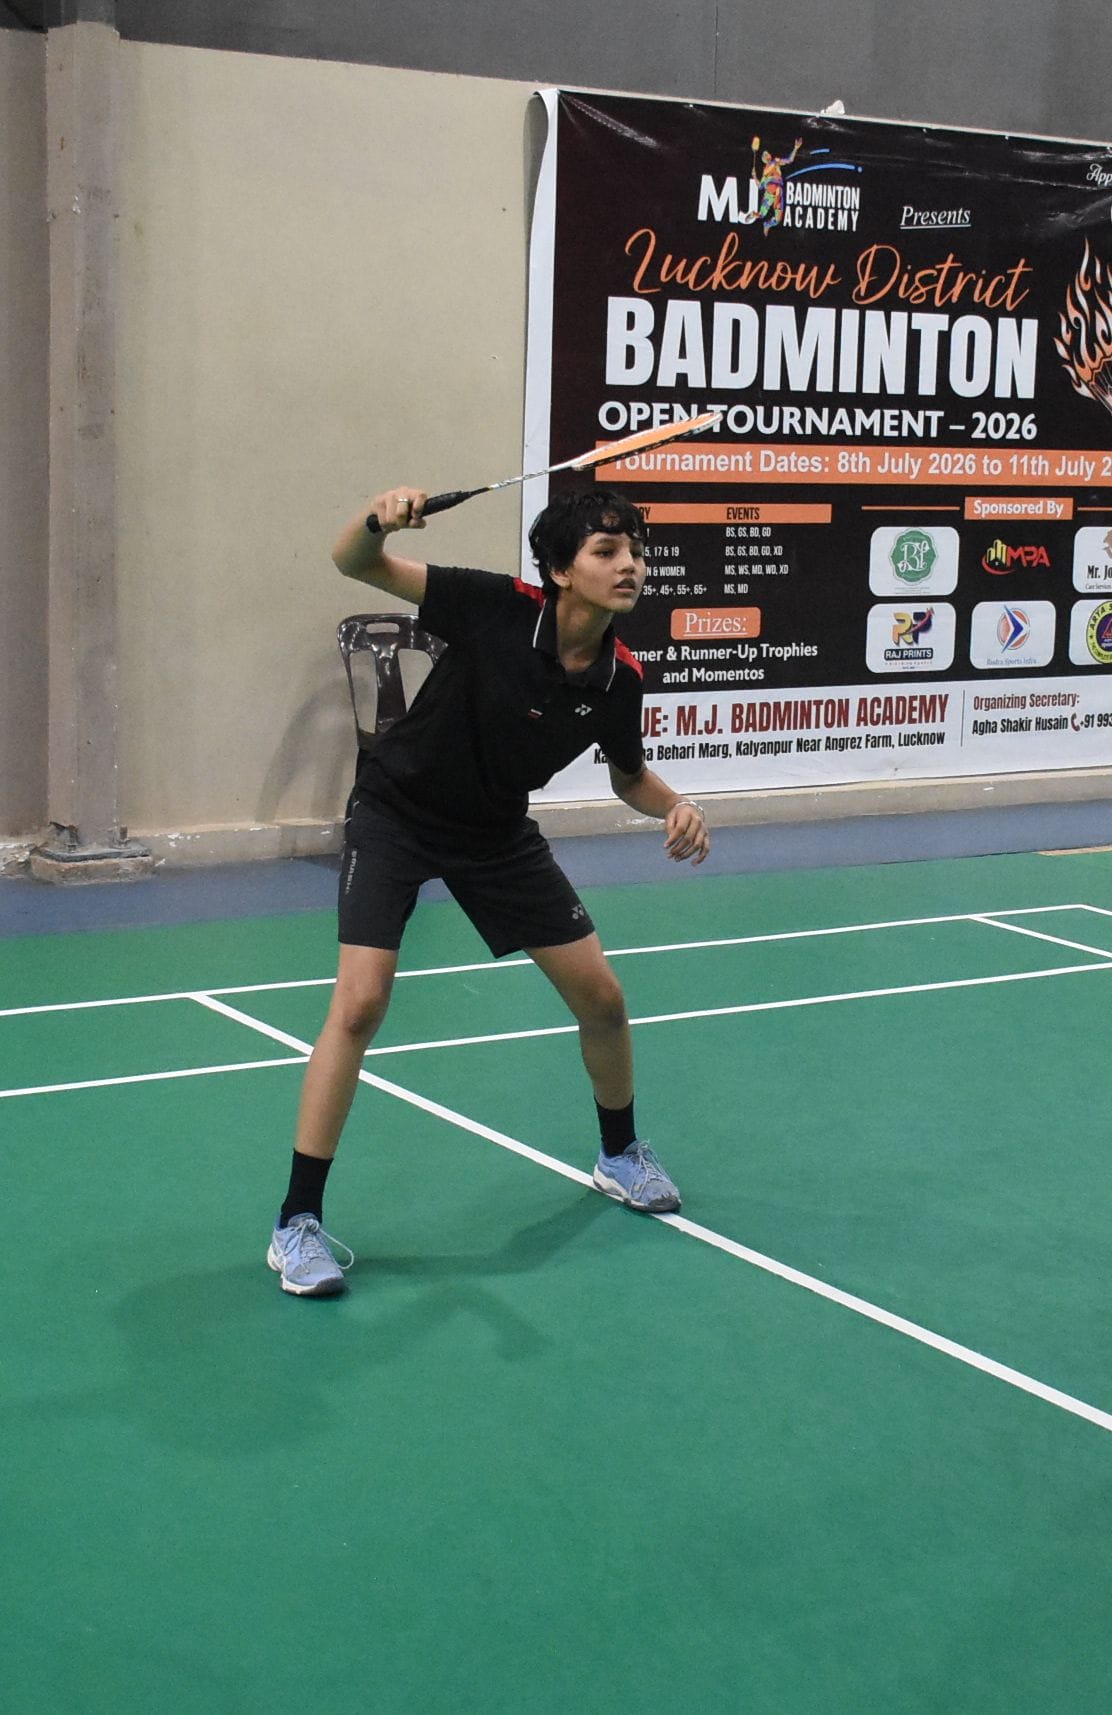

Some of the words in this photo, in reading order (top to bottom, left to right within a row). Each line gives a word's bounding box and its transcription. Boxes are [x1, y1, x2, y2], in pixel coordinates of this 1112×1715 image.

[697, 174, 760, 225] MJ
[786, 181, 861, 210] BADMINTON
[783, 206, 859, 232] ACADEMY
[900, 205, 971, 226] Presents
[624, 228, 840, 299] Lucknow
[852, 243, 1033, 311] District
[605, 296, 1039, 399] BADMINTON
[706, 403, 945, 438] TOURNAMENT
[971, 411, 1038, 440] 2026
[759, 450, 830, 473] Dates:
[837, 452, 871, 474] 8th
[877, 453, 922, 479] July
[928, 454, 976, 475] 2026
[982, 457, 1003, 475] to
[1009, 454, 1049, 476] 11th
[1055, 456, 1096, 481] July
[726, 507, 760, 520] EVENTS
[973, 499, 1043, 517] Sponsored
[1046, 500, 1064, 518] By
[726, 527, 736, 538] BS,
[654, 546, 662, 557] 17
[671, 546, 679, 556] 19
[725, 546, 736, 557] BS,
[773, 546, 783, 556] XD
[659, 566, 686, 577] WOMEN
[724, 565, 737, 576] MS,
[779, 564, 789, 575] XD
[1087, 564, 1101, 579] Mr.
[643, 585, 659, 596] 35+,
[660, 585, 676, 596] 45+,
[677, 585, 693, 596] 55+,
[724, 584, 736, 595] MS,
[737, 584, 748, 594] MD
[684, 612, 748, 633] Prizes:
[630, 650, 663, 662] nner
[666, 646, 678, 661] &
[681, 645, 757, 662] Runner-Up
[760, 642, 818, 661] Trophies
[886, 650, 901, 658] RAJ
[903, 649, 932, 658] PRINTS
[663, 668, 688, 683] and
[692, 667, 765, 683] Momentos
[973, 694, 1026, 711] Organizing
[1029, 692, 1080, 708] Secretary:
[676, 704, 723, 736] M.J.
[731, 698, 850, 733] BADMINTON
[856, 694, 949, 727] ACADEMY
[972, 719, 997, 735] Agha
[1000, 716, 1032, 732] Shakir
[1035, 714, 1068, 731] Husain
[657, 742, 695, 761] Behari
[699, 741, 732, 760] Marg,
[736, 738, 792, 757] Kalyanpur
[796, 736, 821, 752] Near
[824, 734, 862, 752] Angrez
[865, 732, 895, 750] Farm,
[898, 730, 946, 747] Lucknow
